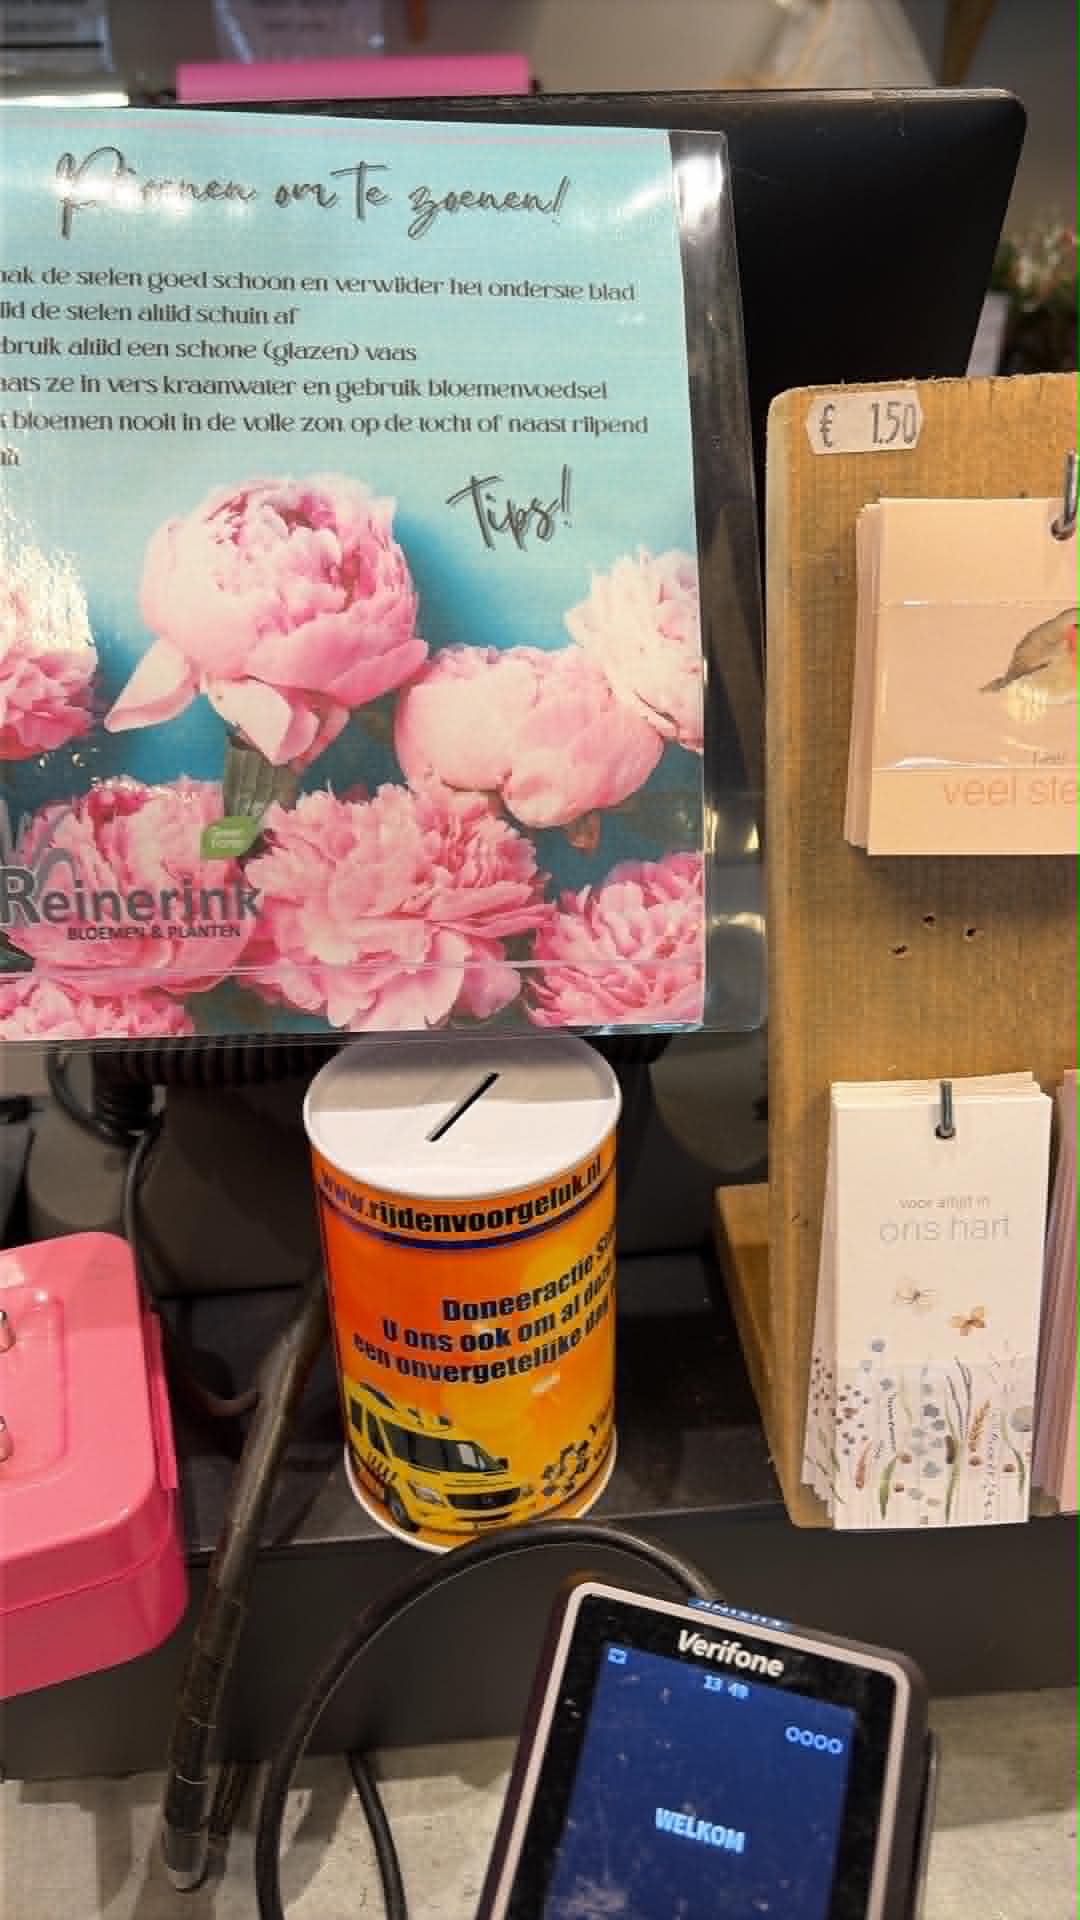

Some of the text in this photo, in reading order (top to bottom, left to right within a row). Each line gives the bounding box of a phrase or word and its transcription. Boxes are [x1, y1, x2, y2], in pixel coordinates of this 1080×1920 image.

[406, 174, 570, 240] zoenen!
[41, 266, 71, 286] de
[77, 268, 143, 287] stelen
[147, 271, 208, 293] goed
[213, 272, 296, 292] schoon
[301, 277, 330, 293] en
[335, 275, 445, 295] verwijder
[449, 277, 482, 297] het
[488, 278, 584, 299] onderste
[589, 283, 636, 301] blad
[31, 301, 60, 320] de
[67, 302, 133, 321] stelen
[138, 303, 192, 323] altijd
[197, 305, 268, 325] schuin
[273, 307, 299, 326] af
[68, 337, 121, 357] altijd
[127, 341, 170, 358] een
[175, 340, 258, 359] schone
[264, 340, 360, 367] (glazen)
[365, 343, 418, 361] vaas
[46, 376, 75, 393] ze
[81, 374, 101, 393] in
[107, 376, 159, 394] vers
[163, 375, 297, 396] kraanwater
[303, 380, 331, 397] en
[336, 378, 422, 403] gebruik
[428, 379, 609, 400] bloemenvoedsel
[12, 409, 113, 431] bloemen
[119, 412, 176, 432] nooit
[183, 412, 201, 432] in
[207, 412, 237, 432] de
[243, 412, 296, 432] volle
[301, 417, 343, 433] zon
[351, 417, 380, 437] op
[384, 413, 413, 433] de
[419, 414, 472, 433] tocht
[477, 414, 503, 433] of
[508, 416, 567, 434] naast
[572, 415, 649, 438] rijpend
[819, 403, 835, 449] €
[445, 464, 572, 552] Tips!
[943, 775, 1017, 808] veel
[67, 925, 241, 942] BLOEMEN & PLANTEN
[897, 1197, 933, 1209] voor
[879, 1213, 1010, 1242] ons hart
[442, 1253, 593, 1322] Doneeractie
[382, 1316, 398, 1343] U
[404, 1327, 453, 1352] ons
[460, 1327, 511, 1352] ook
[517, 1309, 558, 1342] om
[560, 1295, 580, 1324] al
[352, 1331, 391, 1369] een
[396, 1326, 582, 1384] onvergetelijke
[677, 1628, 785, 1678] Verifone
[654, 1806, 746, 1854] WELKOM
